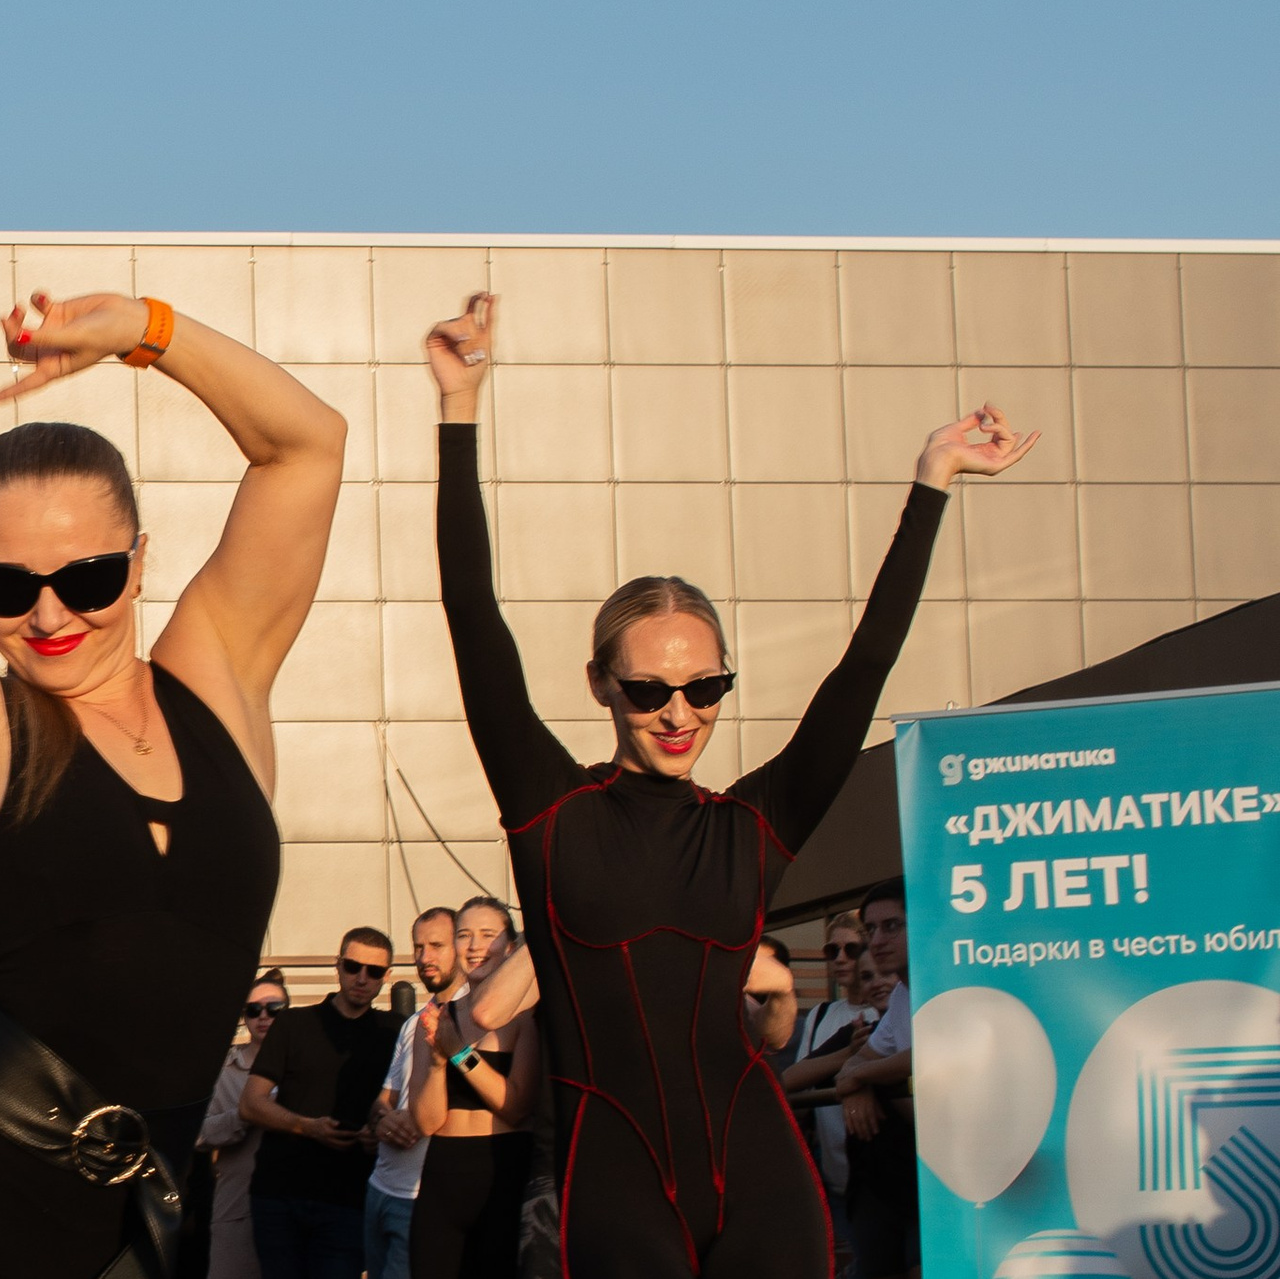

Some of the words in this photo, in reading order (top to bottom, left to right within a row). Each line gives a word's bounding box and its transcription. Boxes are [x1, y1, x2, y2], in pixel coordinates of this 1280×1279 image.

[945, 786, 1280, 846] «ДЖИМАТИКЕ»
[950, 864, 987, 914] 5
[1003, 854, 1149, 911] ЛЕТ!
[953, 938, 1079, 967] Подарки
[1089, 936, 1105, 958] в
[1112, 934, 1196, 957] честь
